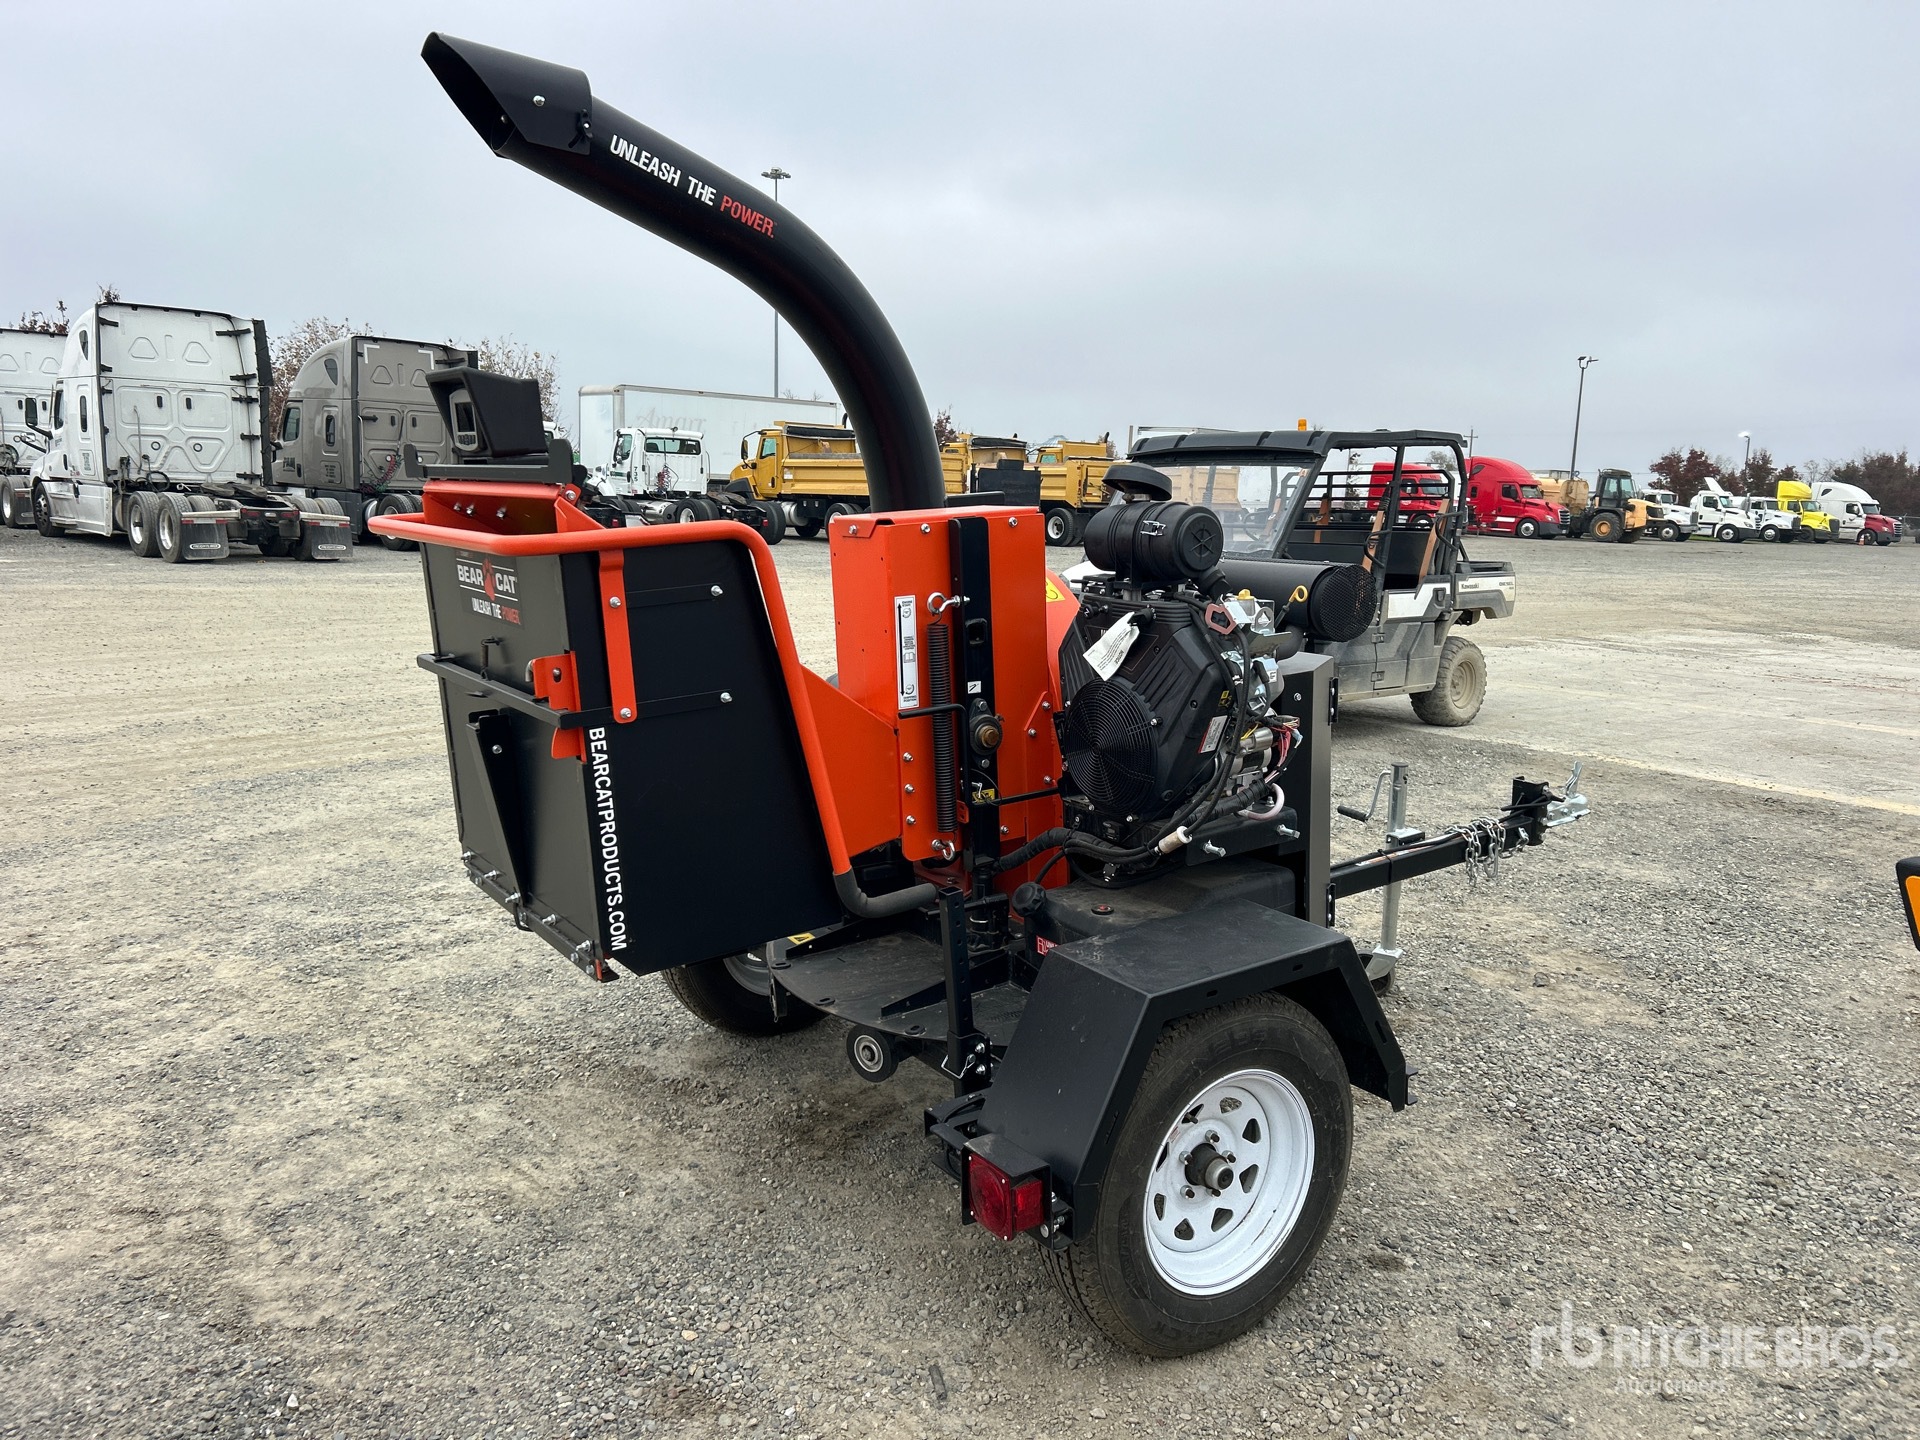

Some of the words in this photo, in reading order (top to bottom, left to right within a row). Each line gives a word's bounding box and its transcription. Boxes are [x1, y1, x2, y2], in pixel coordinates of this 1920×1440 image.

[610, 134, 682, 187] UNLEASH
[688, 175, 717, 206] THE
[457, 564, 485, 586] BEAR
[495, 572, 516, 594] CAT
[588, 726, 628, 951] BEARCATPRODUCTS.COM
